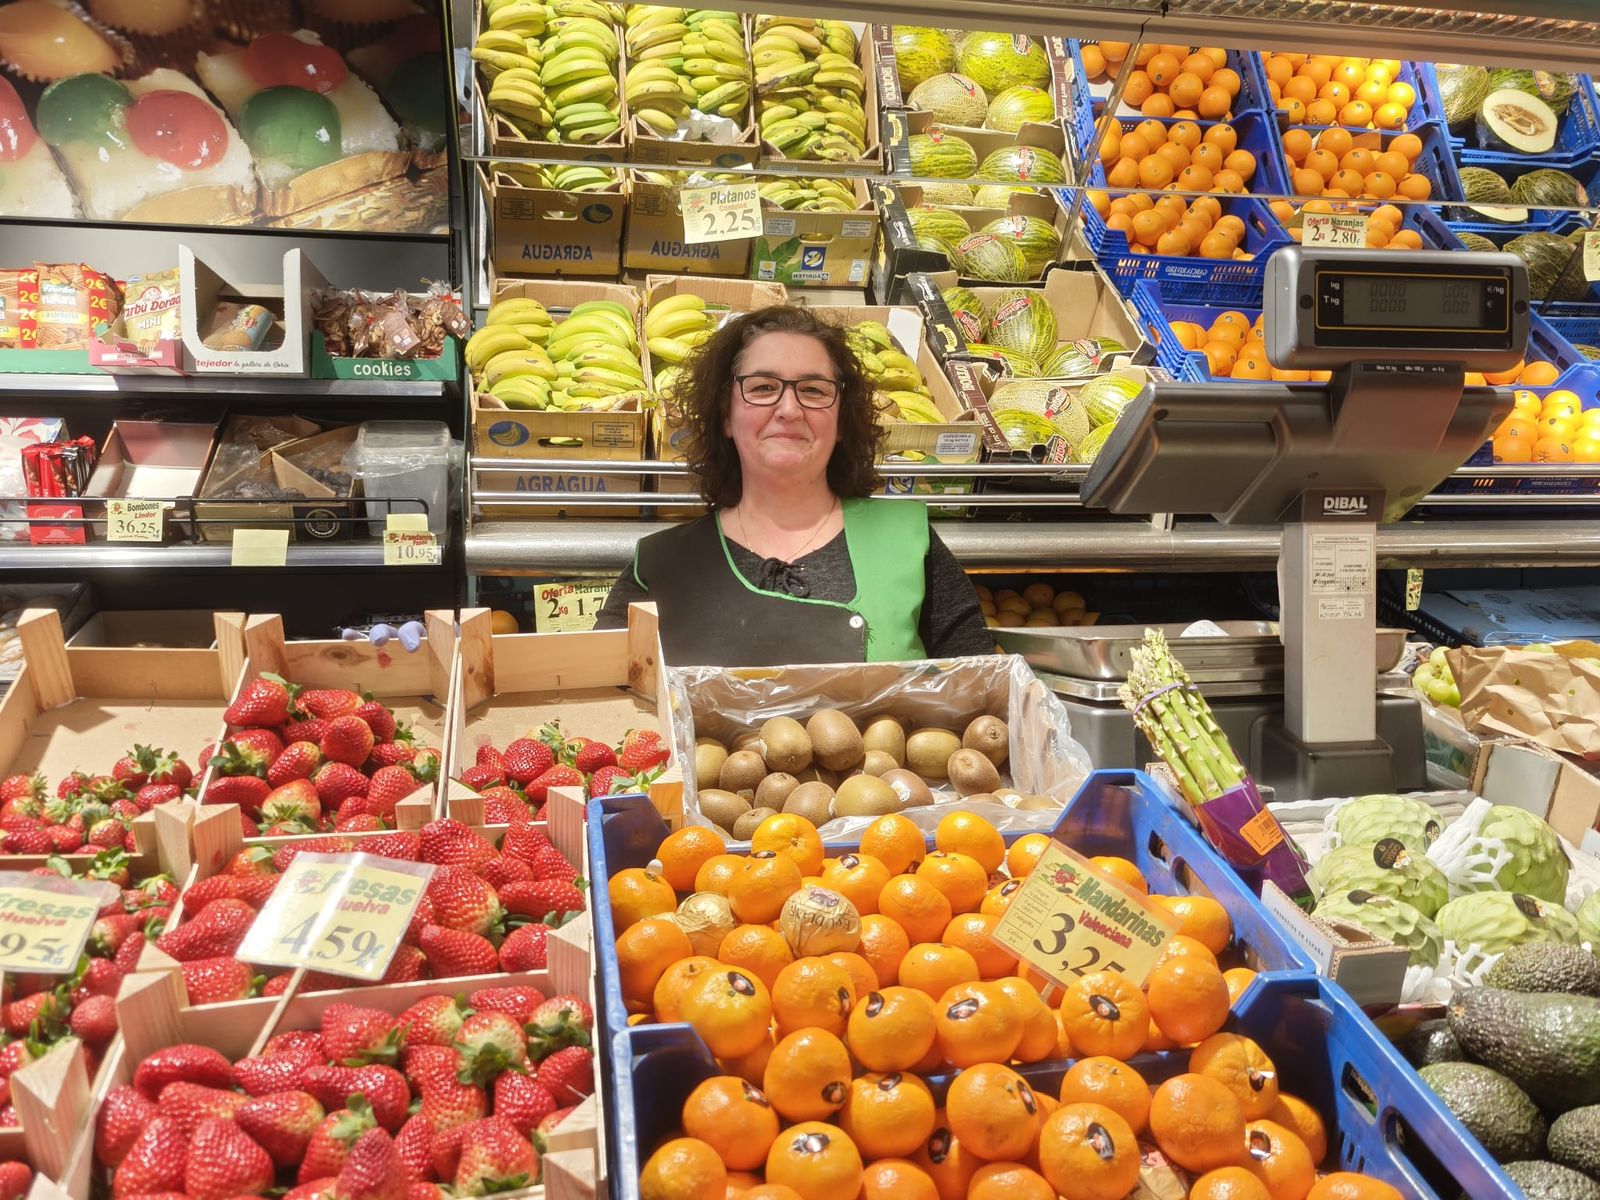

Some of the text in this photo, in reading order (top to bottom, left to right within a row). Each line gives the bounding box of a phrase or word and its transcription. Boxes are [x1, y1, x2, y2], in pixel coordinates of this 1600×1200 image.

[1331, 281, 1340, 290] kg
[196, 359, 233, 368] tejedor
[353, 360, 412, 377] cookies
[515, 475, 578, 493] AGRAGUA
[127, 501, 160, 512] Bombones
[1323, 496, 1369, 510] DIBAL
[541, 582, 614, 601] Oferta Naranj
[546, 597, 561, 619] 2
[321, 870, 416, 906] Fesas
[1075, 876, 1166, 948] Mandarinas
[1077, 909, 1135, 950] Valenciana
